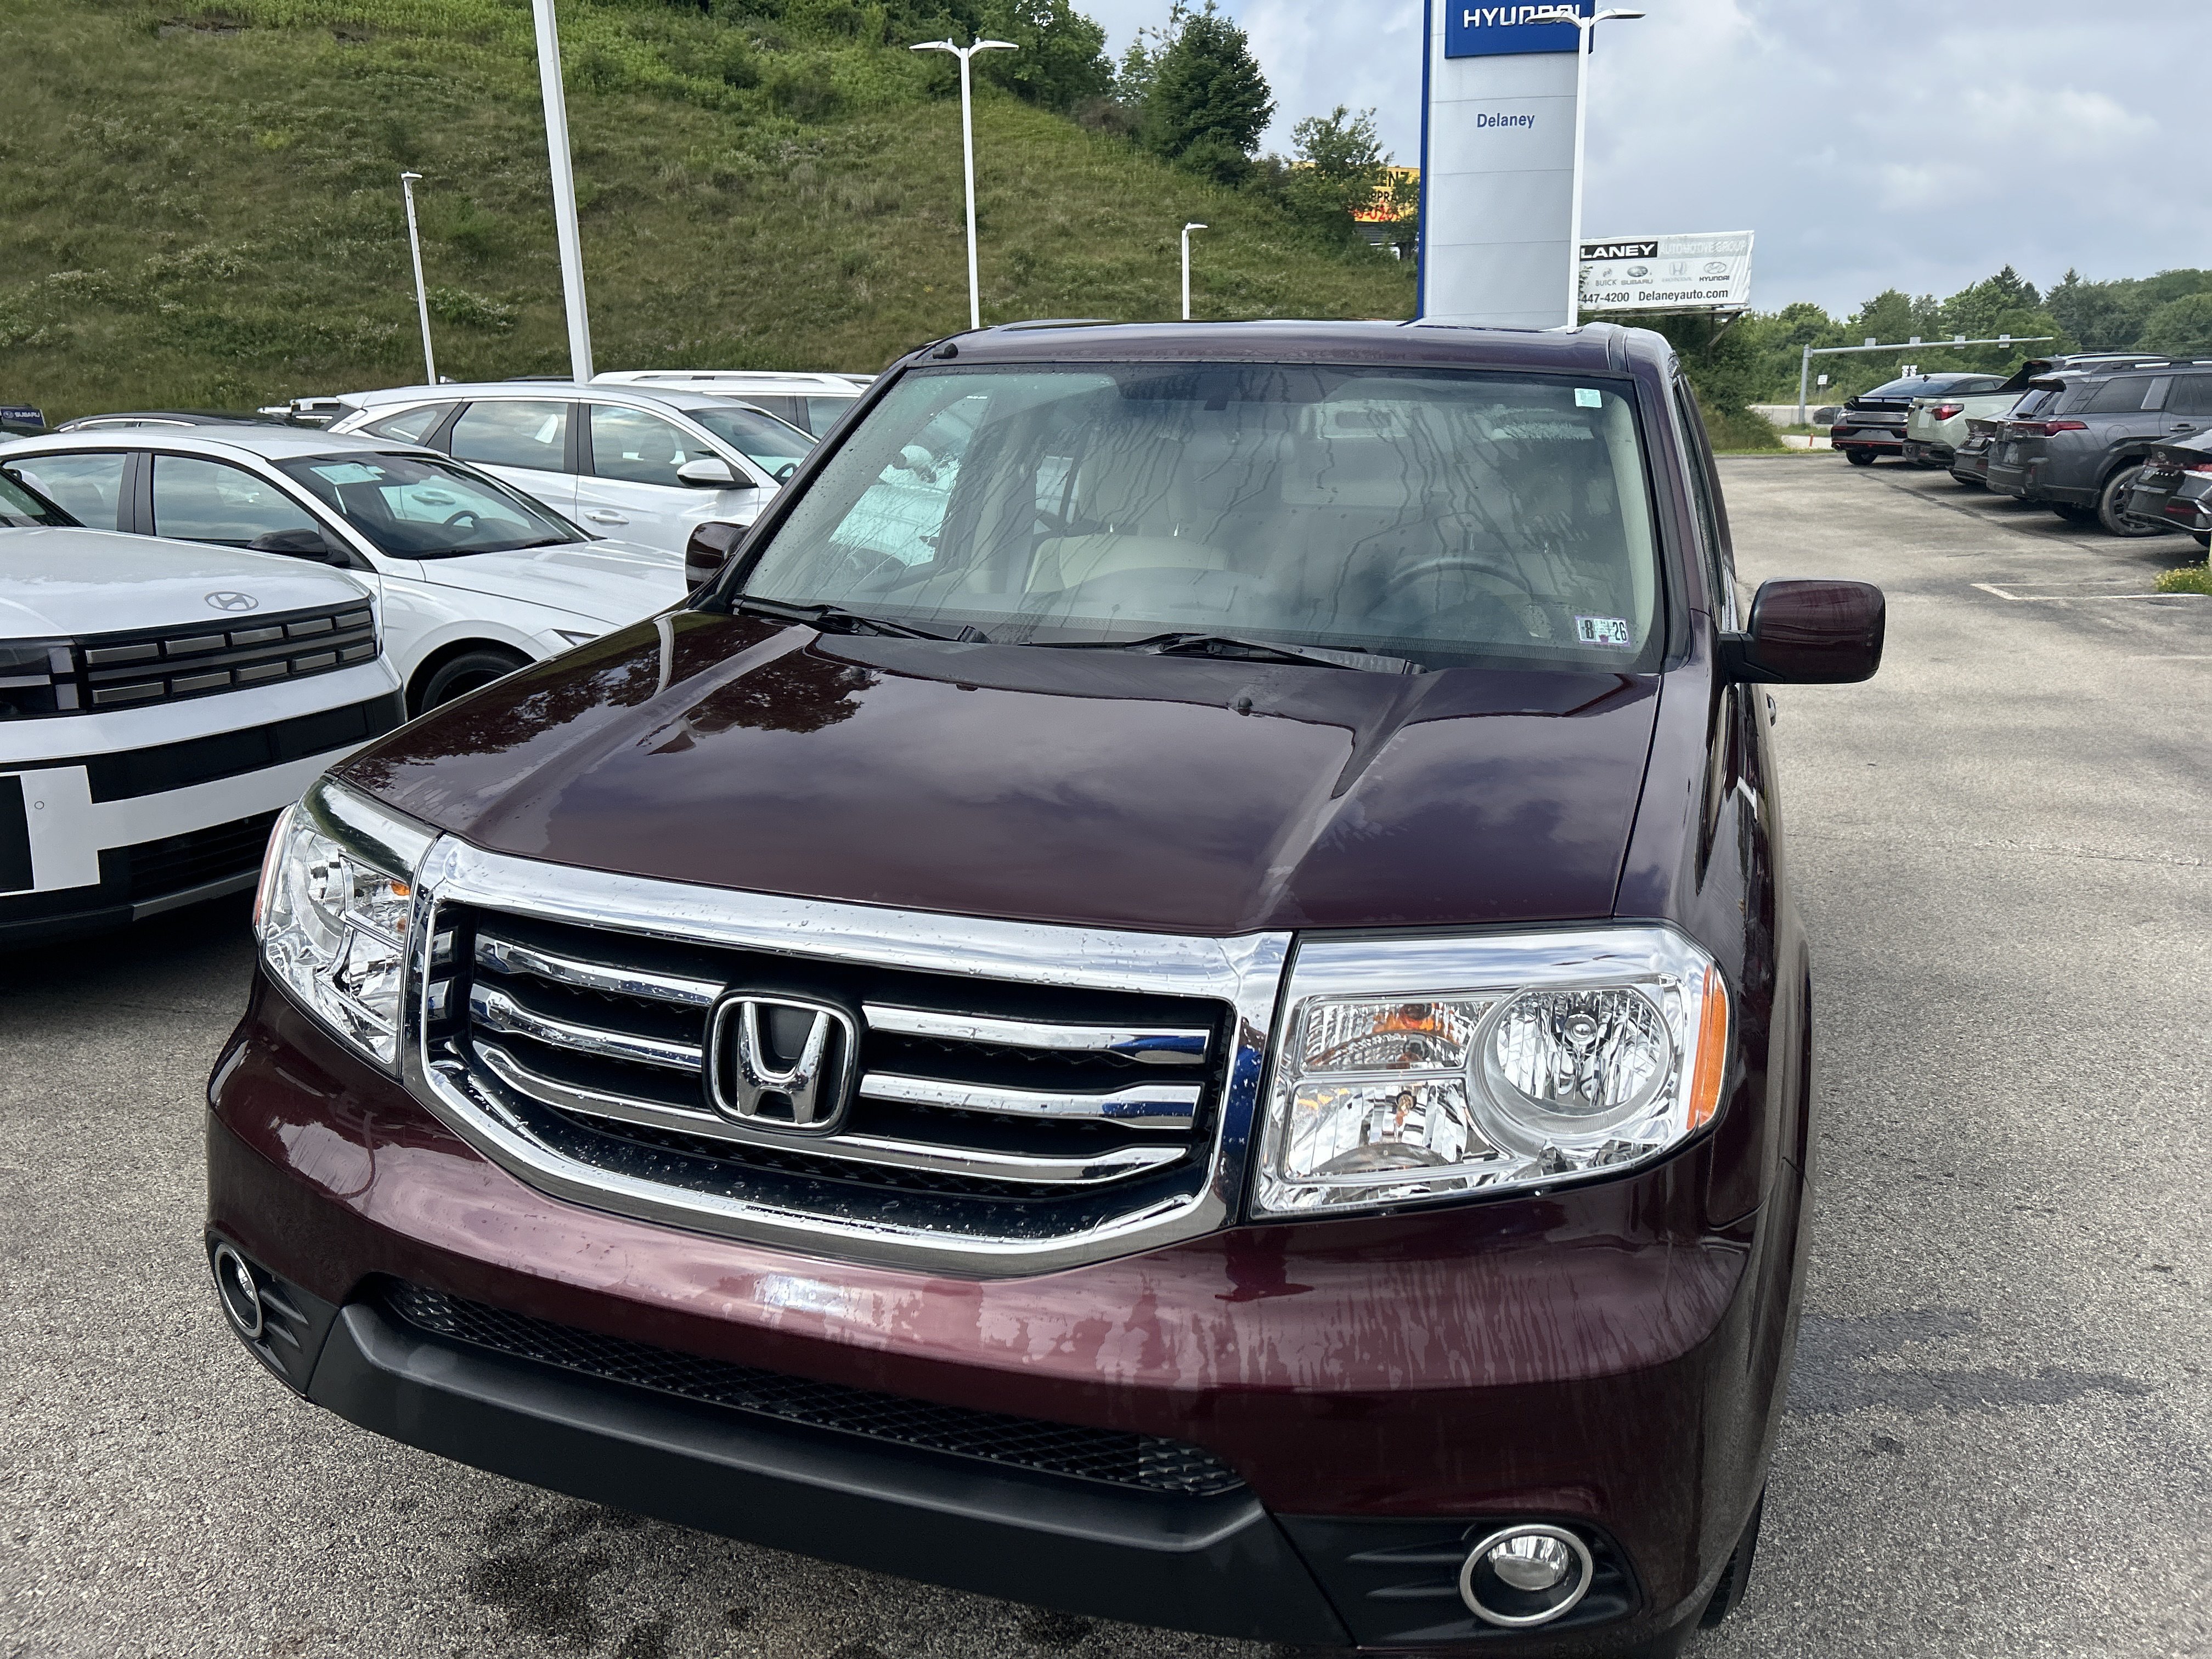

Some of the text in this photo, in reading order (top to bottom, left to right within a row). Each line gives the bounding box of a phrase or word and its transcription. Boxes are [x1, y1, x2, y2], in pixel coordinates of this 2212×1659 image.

[1477, 112, 1535, 129] Delaney
[1580, 244, 1655, 259] LANEY
[1638, 290, 1729, 302] Delaneyauto.com
[1584, 619, 1594, 639] 8
[1612, 621, 1627, 641] 26
